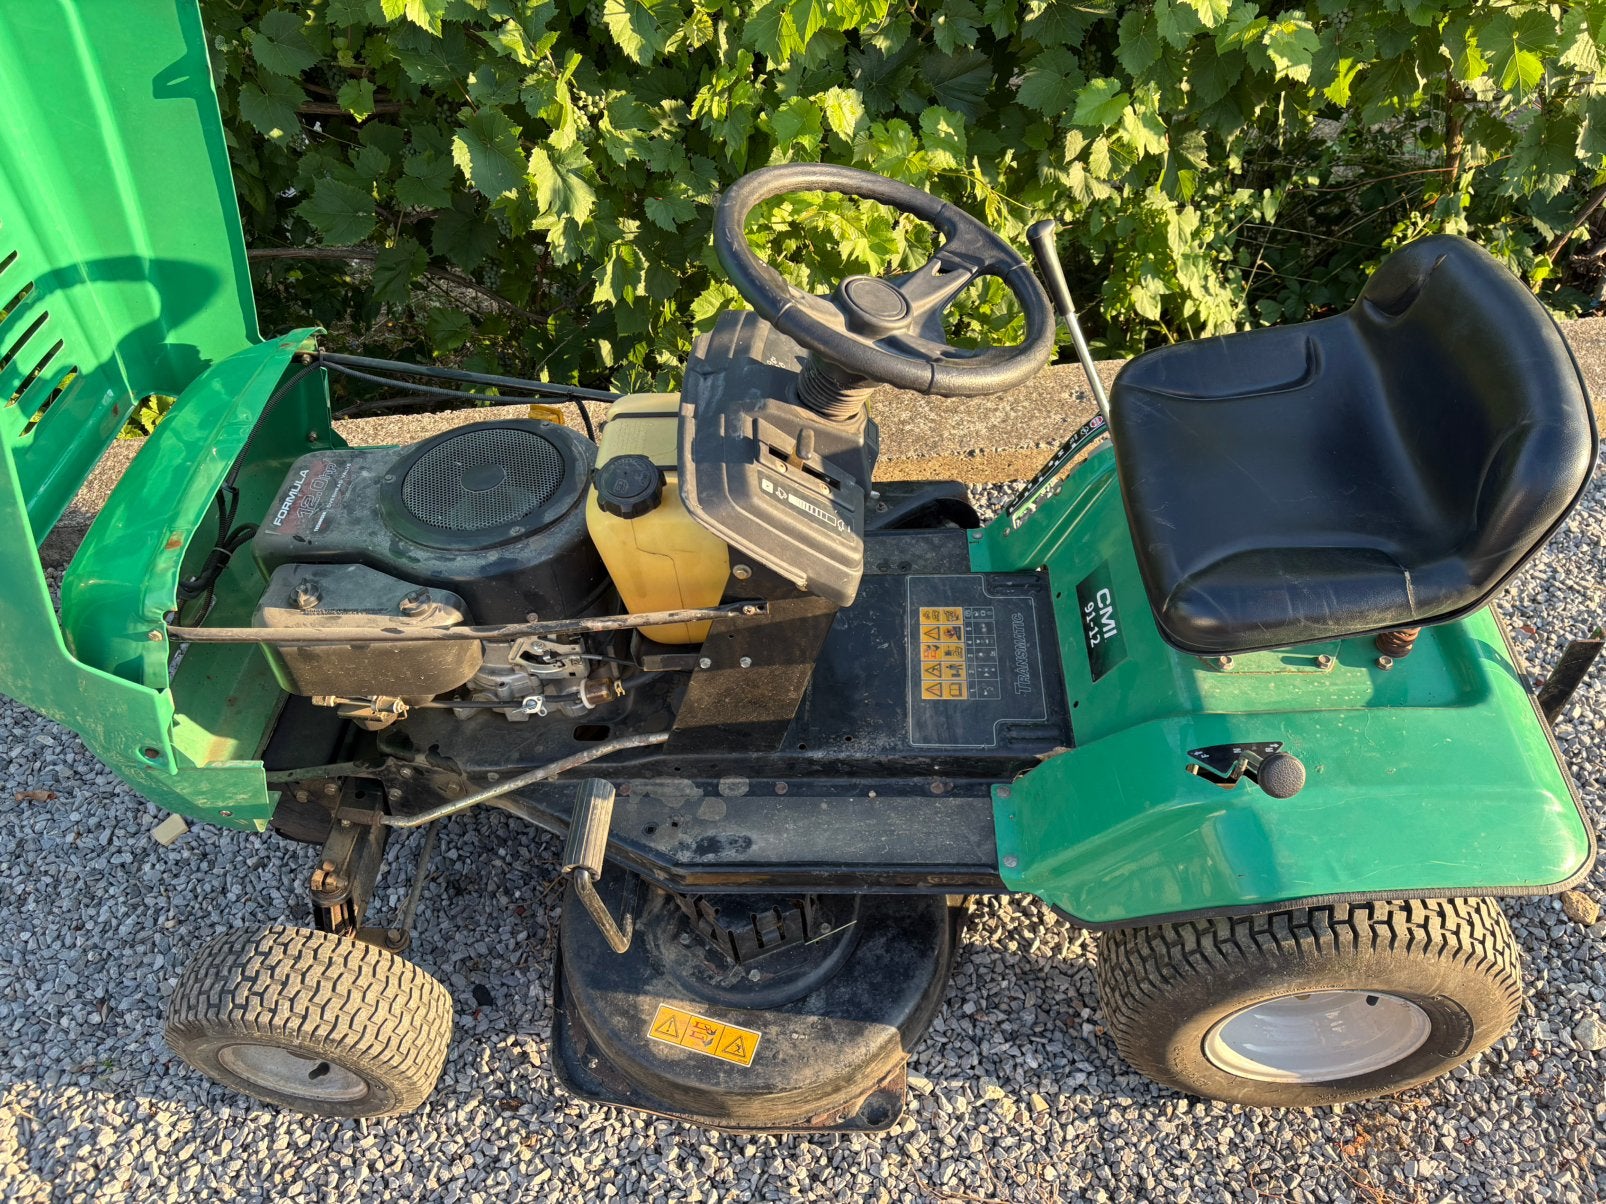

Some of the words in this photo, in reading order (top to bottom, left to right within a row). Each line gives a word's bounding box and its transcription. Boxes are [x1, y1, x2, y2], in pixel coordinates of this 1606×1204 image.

[273, 469, 310, 526] FORMULA
[297, 462, 337, 519] 12.0hp
[1084, 601, 1101, 648] 91-12
[1096, 587, 1118, 639] CMI
[1011, 612, 1030, 696] TRANSMATIC
